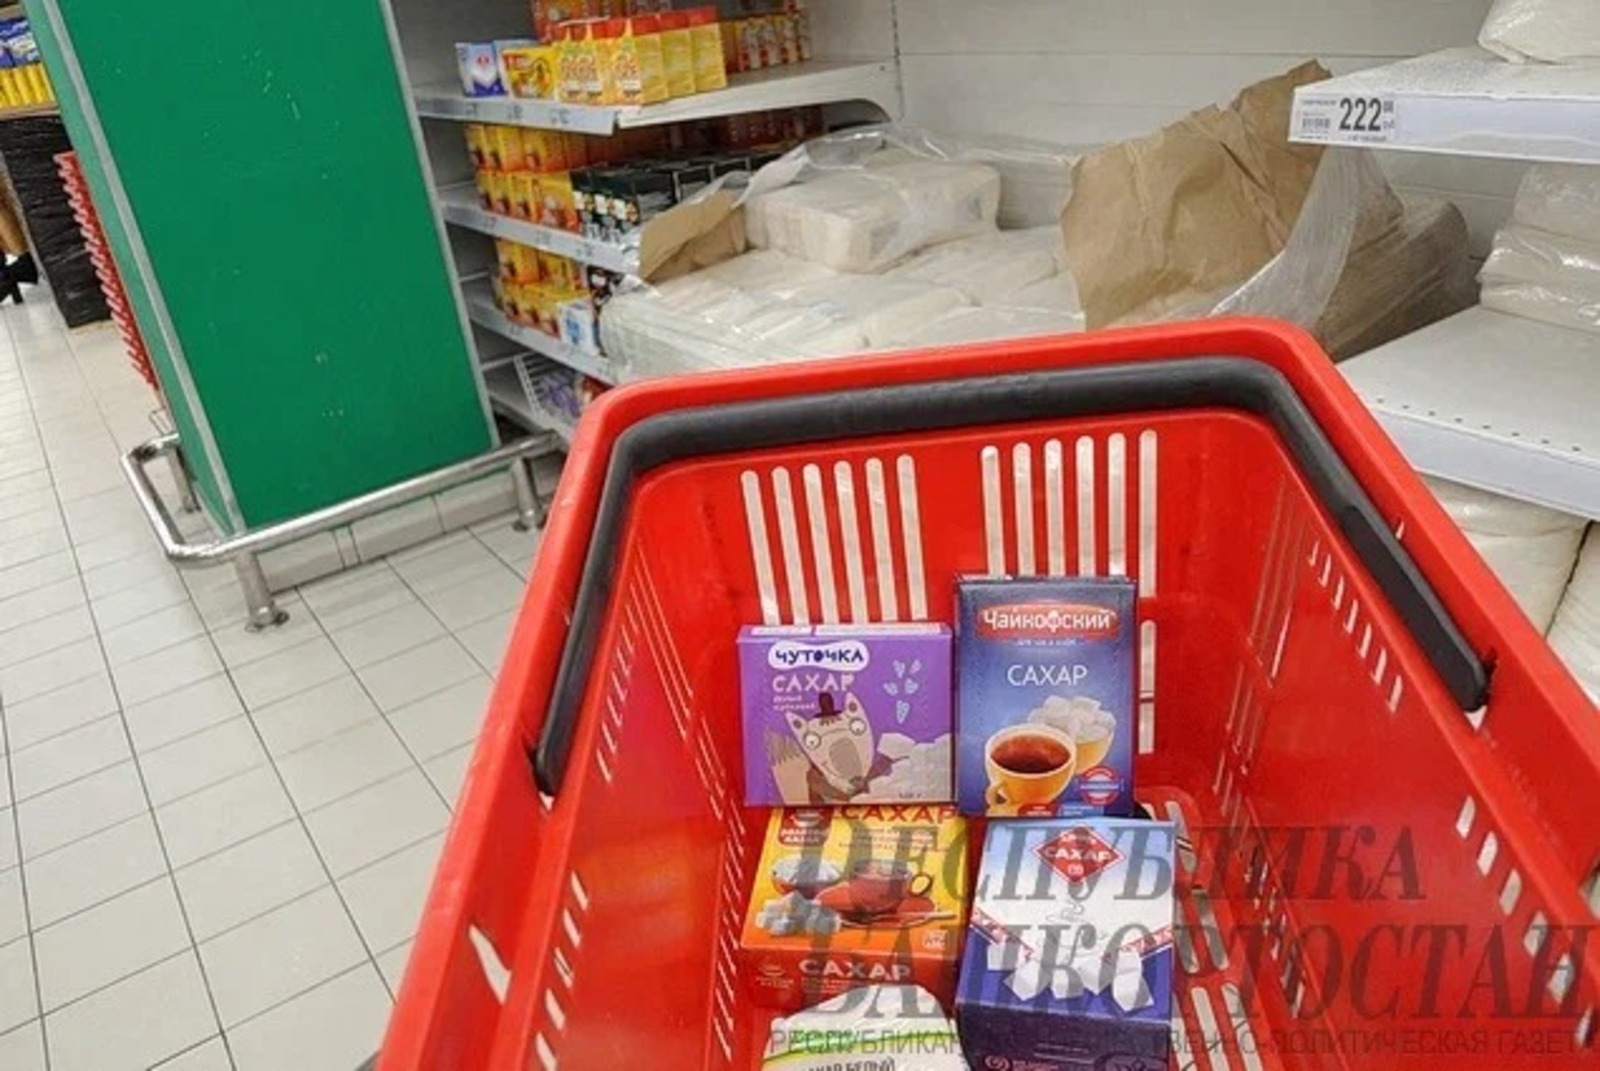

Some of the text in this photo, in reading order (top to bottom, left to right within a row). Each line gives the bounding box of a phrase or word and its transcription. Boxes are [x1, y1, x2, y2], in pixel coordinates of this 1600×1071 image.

[1339, 97, 1382, 131] 222
[983, 606, 1111, 633] Чайкофский
[775, 648, 865, 666] ЧУТОЧКА
[772, 673, 855, 693] САХАР
[1006, 664, 1089, 687] САХАР
[840, 804, 957, 824] САХАР
[1044, 847, 1112, 864] САХАР
[799, 959, 911, 981] САХАР
